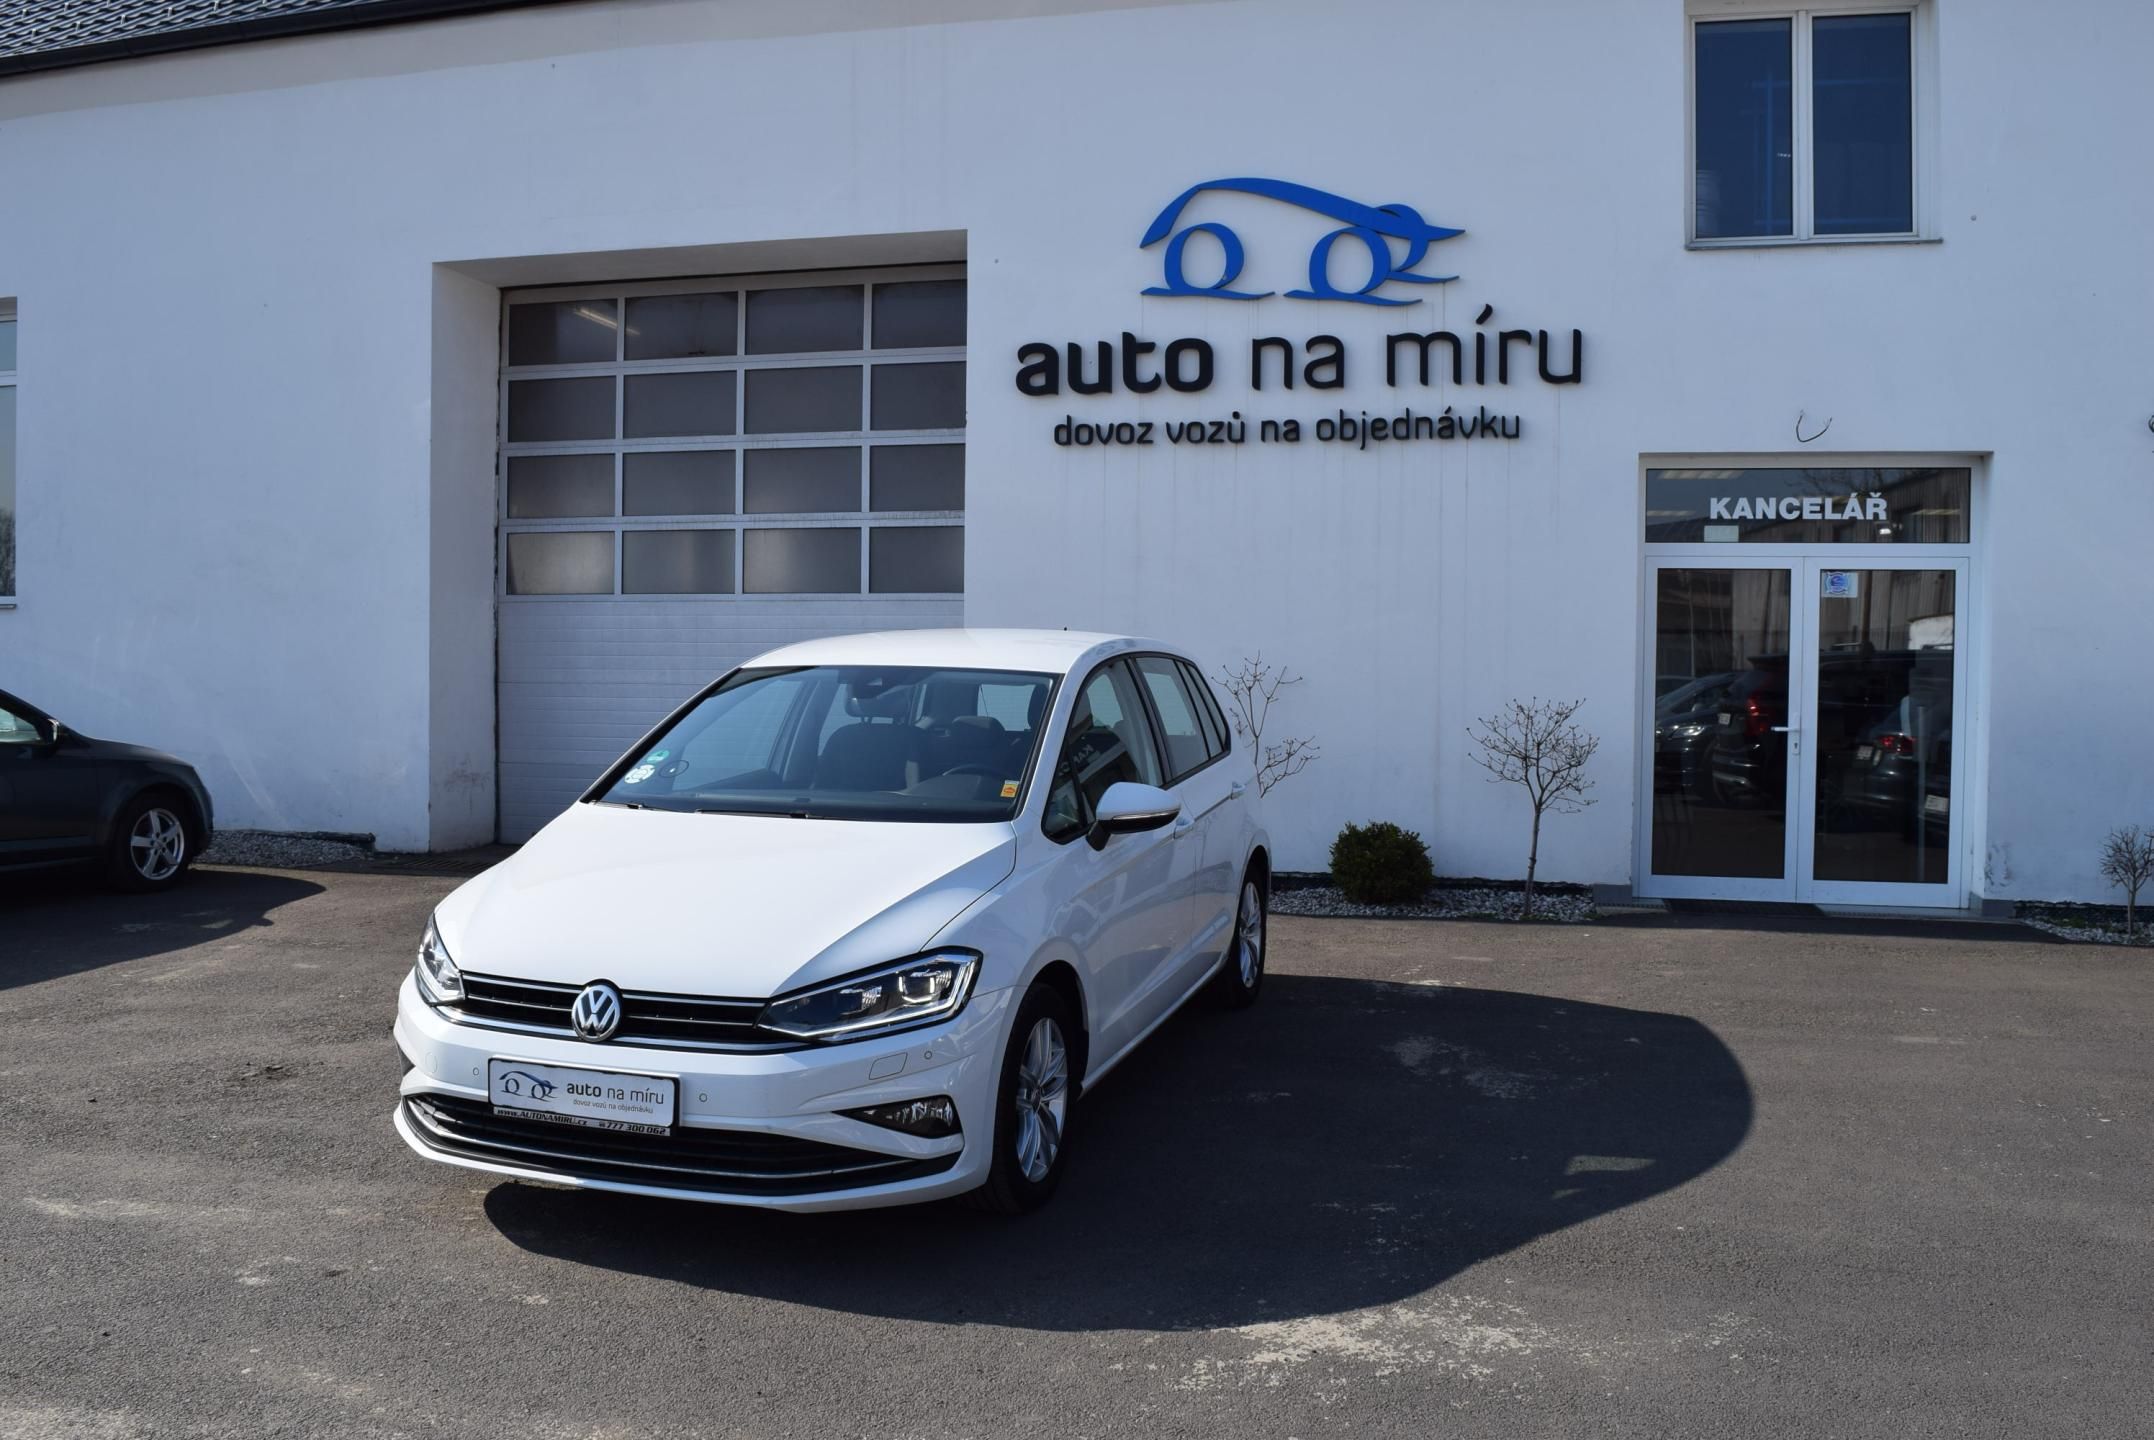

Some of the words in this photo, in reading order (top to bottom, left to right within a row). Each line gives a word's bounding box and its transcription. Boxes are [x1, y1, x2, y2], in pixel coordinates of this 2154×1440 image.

[1015, 332, 1214, 396] auto
[1251, 335, 1345, 391] na
[1386, 303, 1582, 387] míru
[1053, 415, 1154, 446] dovoz
[1165, 411, 1246, 444] vozů
[1260, 418, 1301, 443] na
[1315, 405, 1520, 451] objednávku
[1710, 492, 1887, 520] KANCELÁŘ
[566, 1082, 602, 1098] auto
[607, 1087, 625, 1100] na
[629, 1087, 665, 1105] míru
